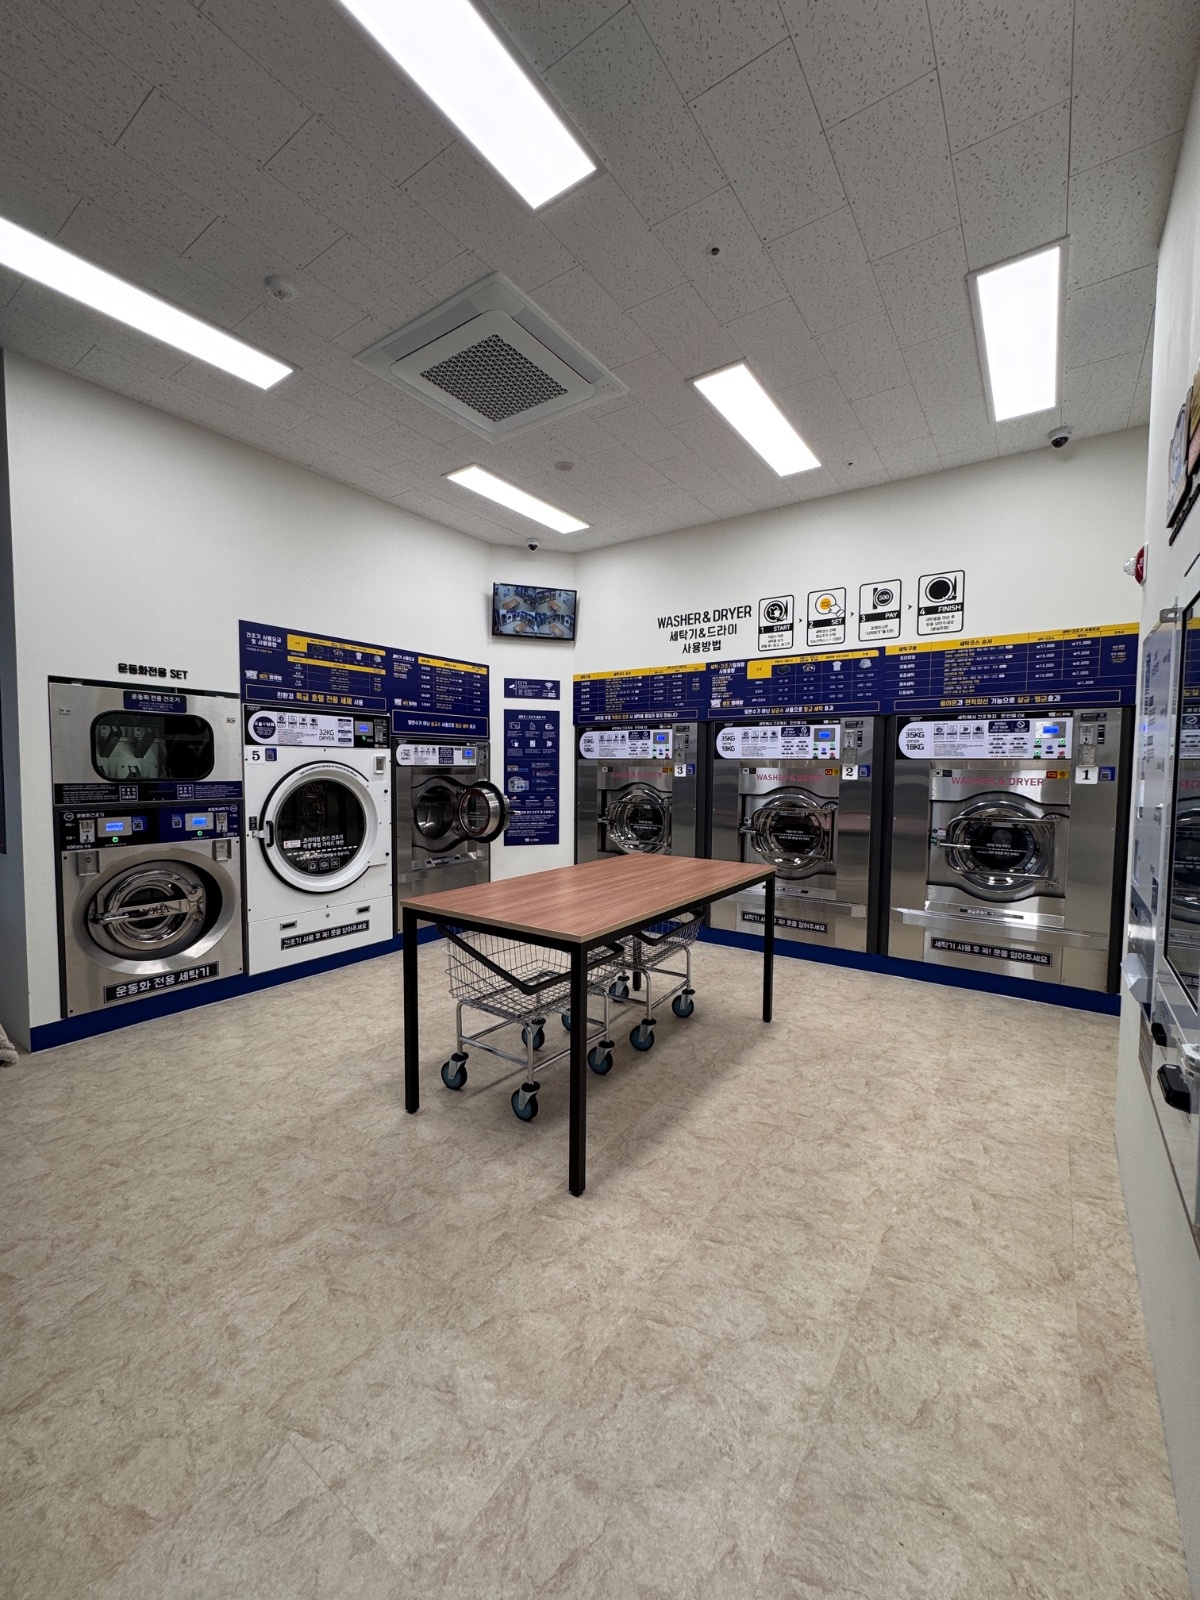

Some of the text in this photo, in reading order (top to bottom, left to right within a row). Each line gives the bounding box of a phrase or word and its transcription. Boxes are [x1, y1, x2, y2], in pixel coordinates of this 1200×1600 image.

[938, 604, 961, 612] FINISH
[657, 605, 752, 629] WASHER & DRYER
[669, 623, 737, 642] 세탁기&드라이
[773, 624, 790, 632] START
[682, 639, 721, 654] 사용방법
[118, 663, 189, 680] 운동화전용 SET
[131, 693, 150, 701] 운동화
[277, 691, 294, 699] 친환경
[296, 692, 309, 701] 특급
[312, 694, 325, 703] 호텔
[965, 698, 989, 706] 원적외선
[991, 697, 1015, 705] 기능으로
[252, 750, 261, 761] 5
[678, 766, 683, 774] 3
[845, 767, 854, 777] 2
[1082, 769, 1090, 780] 1
[952, 777, 995, 785] WASHER
[1009, 777, 1045, 786] DRYER
[744, 913, 760, 922] 세탁기
[283, 937, 302, 946] 건조기
[303, 935, 314, 943] 사용
[330, 929, 341, 937] 문을
[342, 922, 367, 934] 닫아주세요
[934, 940, 956, 950] 세탁기
[958, 944, 971, 952] 사용
[993, 948, 1008, 957] 문을
[1010, 951, 1048, 963] 열어주세요
[116, 966, 210, 998] 운동화 전용 세탁기
